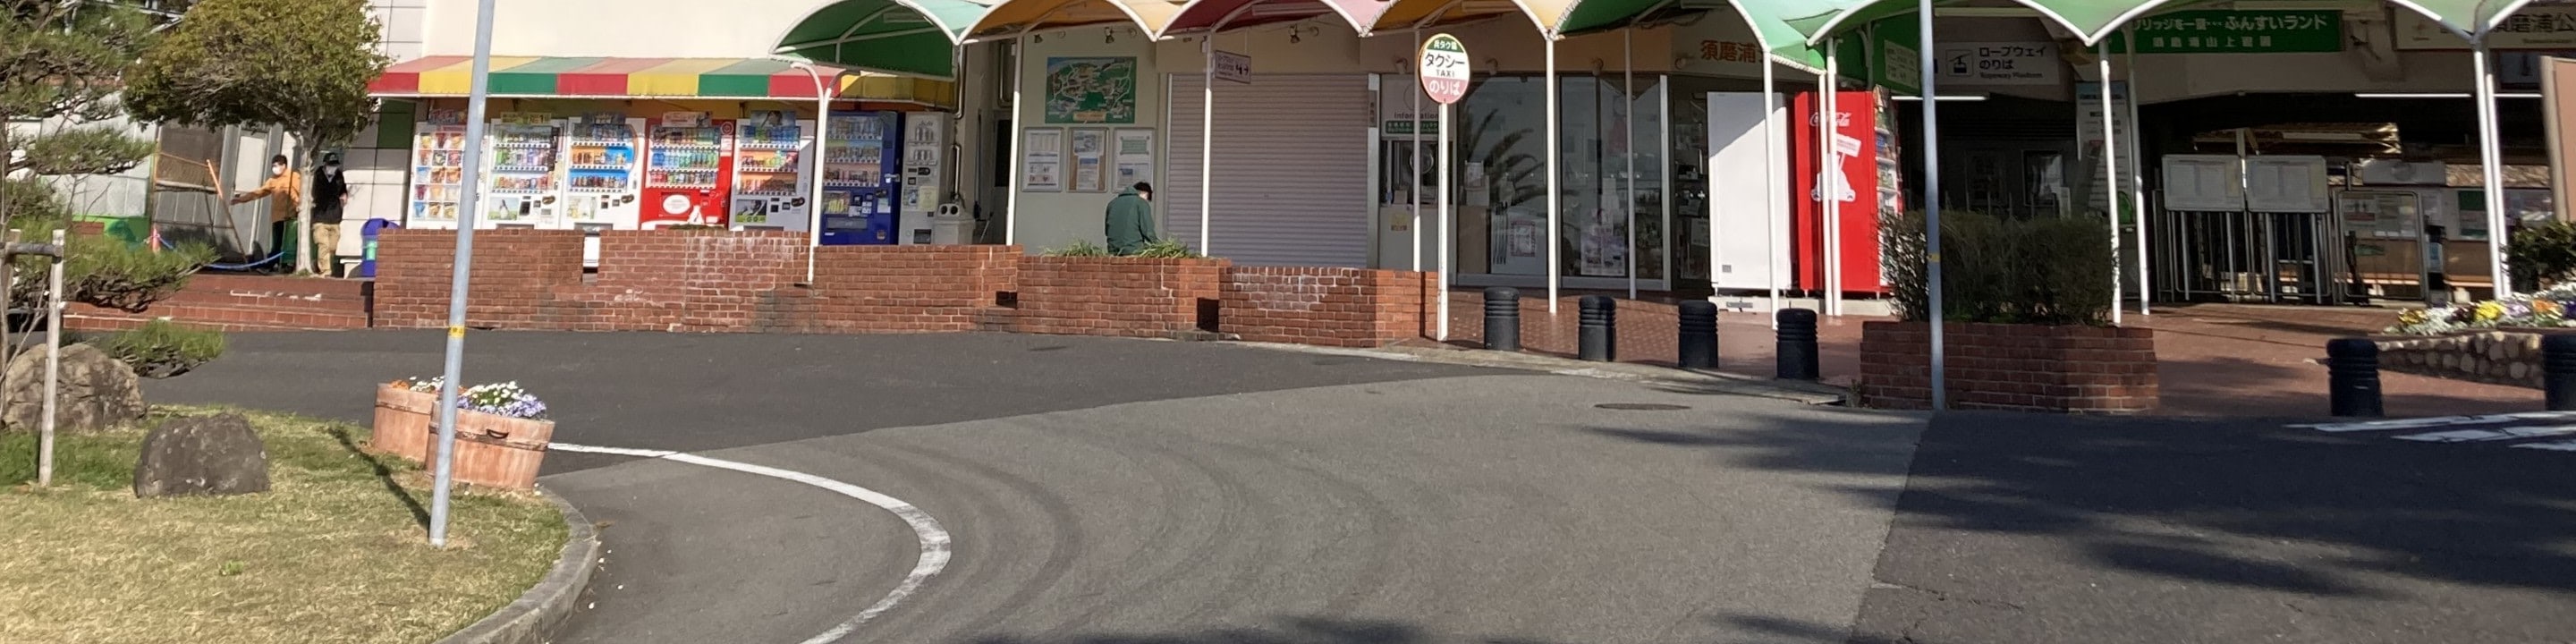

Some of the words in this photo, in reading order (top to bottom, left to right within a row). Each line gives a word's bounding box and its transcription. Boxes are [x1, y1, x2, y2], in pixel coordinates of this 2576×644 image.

[1700, 39, 1763, 63] 須磨浦
[1979, 46, 2046, 57] ロープウェイ
[1425, 52, 1465, 68] タクシー
[1979, 59, 2013, 70] のりば
[1436, 69, 1455, 77] TAXI
[1429, 80, 1461, 96] のりば
